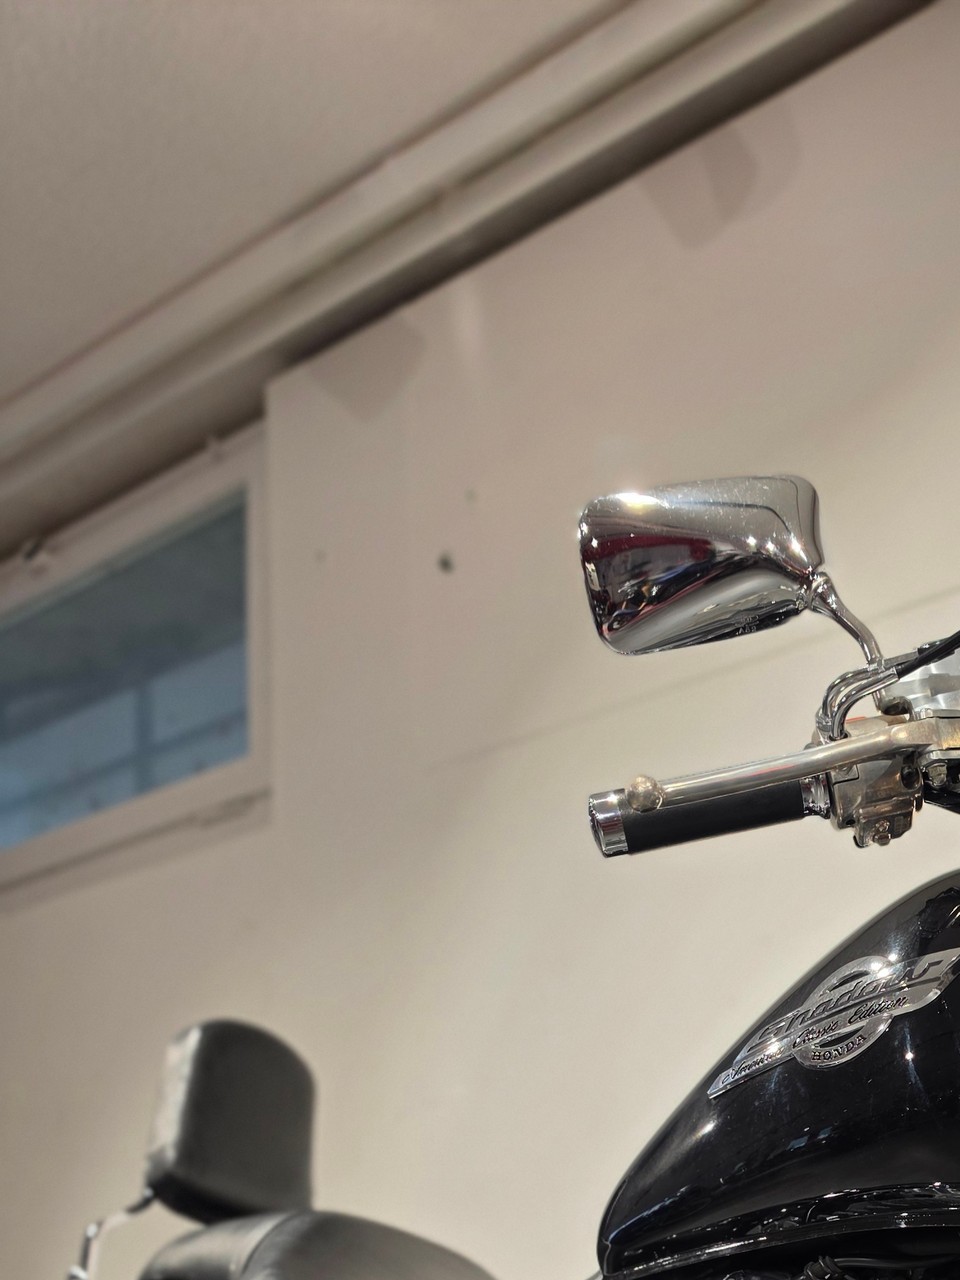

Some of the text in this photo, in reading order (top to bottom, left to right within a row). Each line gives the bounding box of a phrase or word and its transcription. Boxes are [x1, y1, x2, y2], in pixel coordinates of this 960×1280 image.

[793, 1020, 838, 1049] Classic
[848, 996, 908, 1025] Edition
[812, 1034, 867, 1061] HONDA
